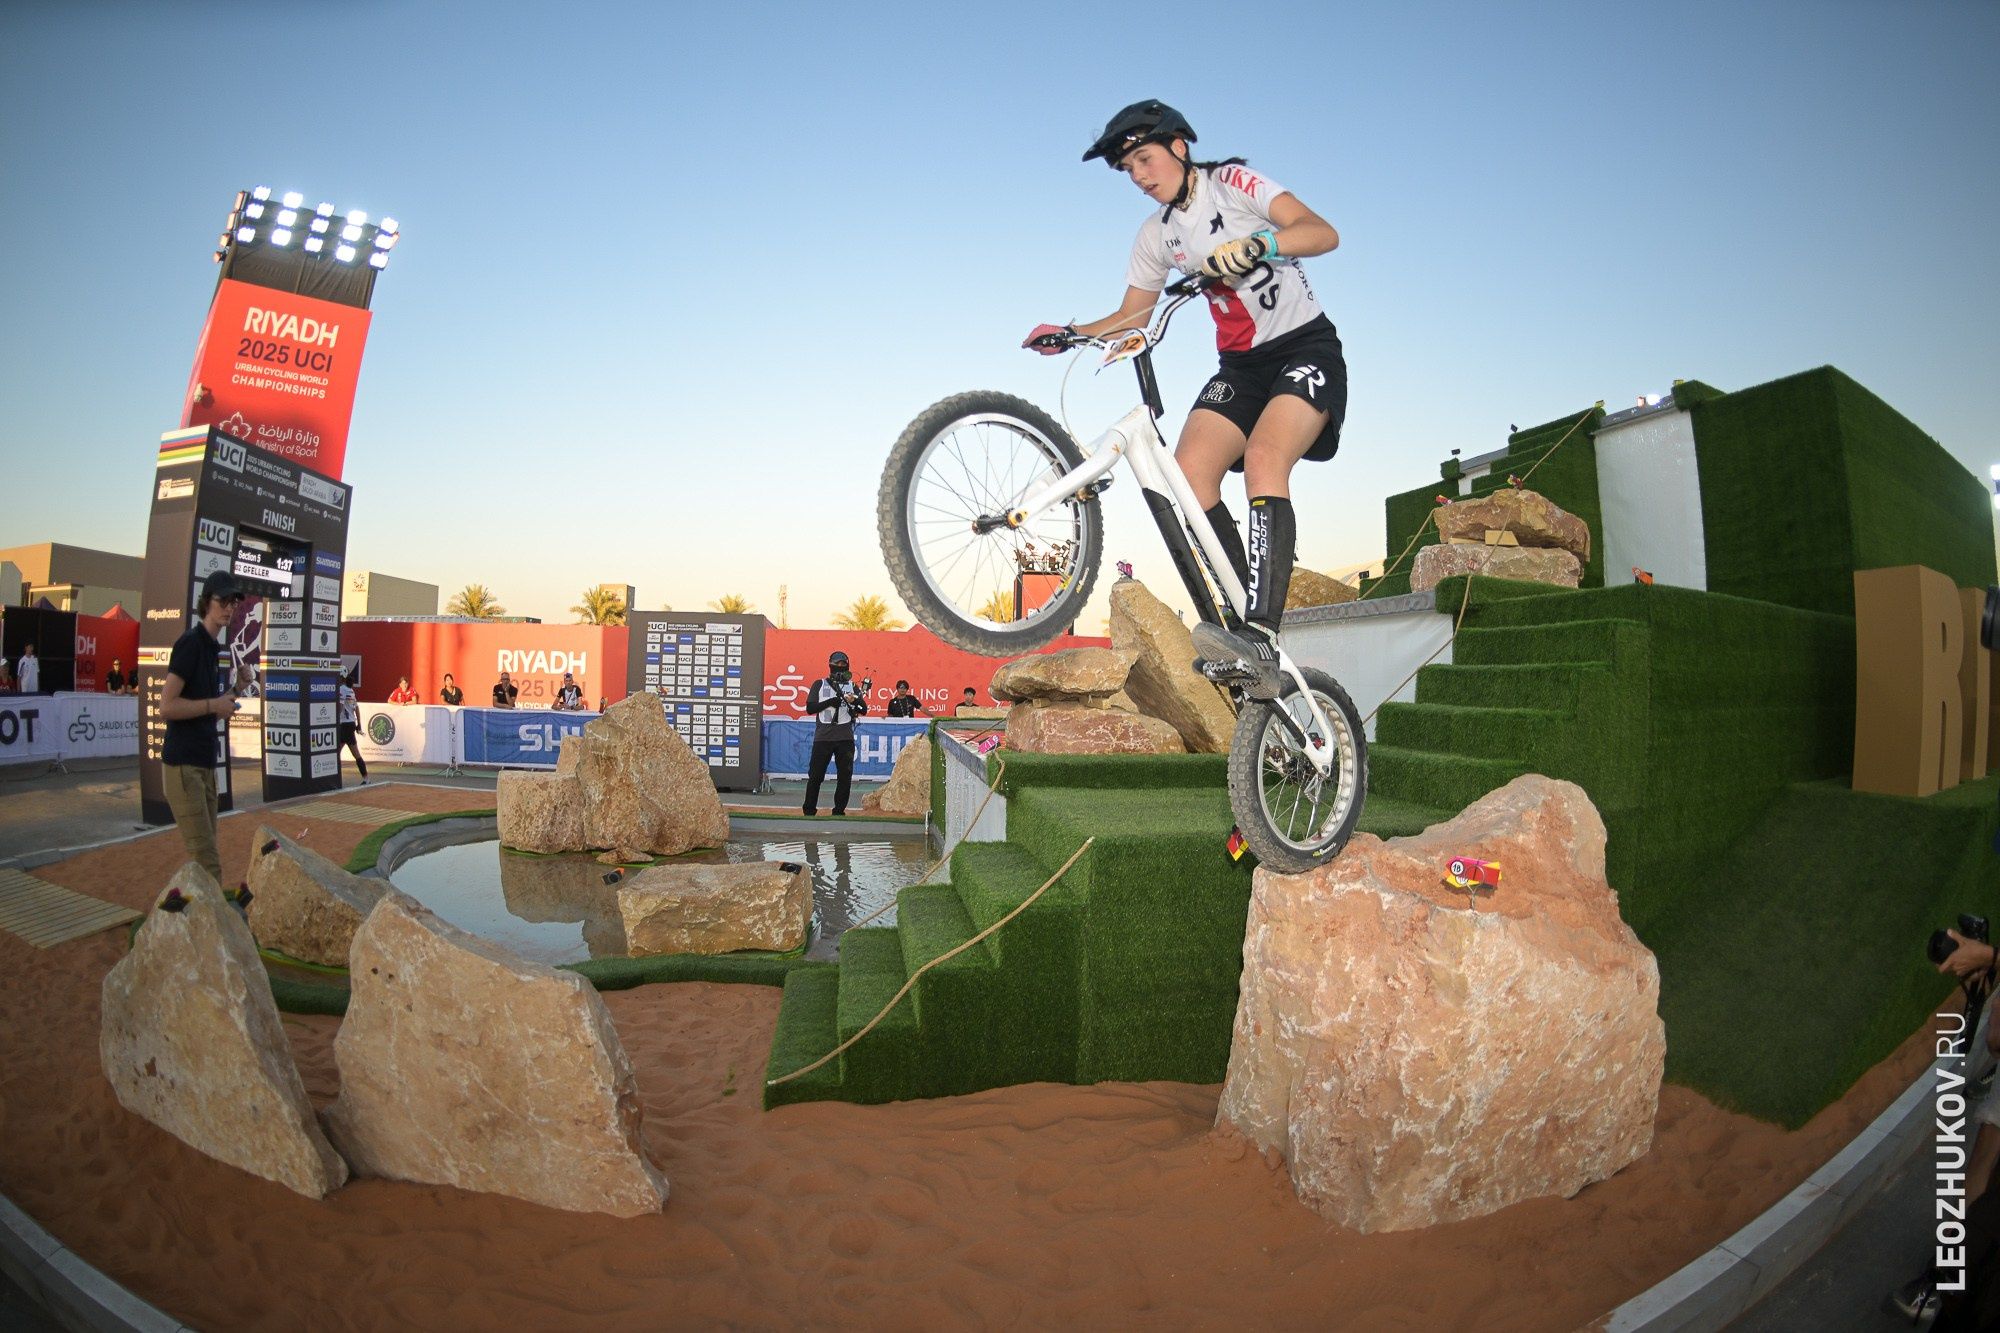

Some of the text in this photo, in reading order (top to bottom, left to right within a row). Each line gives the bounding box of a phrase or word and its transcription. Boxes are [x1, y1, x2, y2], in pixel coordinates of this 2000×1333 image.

[243, 307, 339, 348] RIYADH
[237, 338, 333, 372] 2025 UCI
[235, 362, 329, 386] URBAN CYCLING WORLD
[232, 374, 326, 399] CHAMPIONSHIPS
[1202, 393, 1223, 401] CYCLE
[258, 424, 320, 447] وزارة الرياضة
[256, 440, 317, 457] Ministry of Sport
[220, 444, 243, 467] UCI
[262, 508, 296, 532] FINISH
[207, 527, 230, 546] UCI
[238, 550, 261, 563] Section 5
[316, 557, 341, 569] SHIMANO
[243, 565, 269, 577] GFELLER
[277, 558, 293, 571] 1:37
[281, 586, 289, 598] 10
[316, 613, 335, 622] TISSOT
[154, 651, 169, 661] UCI
[498, 649, 586, 675] RIYADH
[275, 659, 290, 667] UCI
[318, 660, 329, 669] UCI
[265, 683, 299, 692] SHIMANO
[310, 684, 336, 692] SHIMANO
[878, 688, 949, 700] CYLING
[99, 721, 123, 730] SAUDI
[272, 732, 296, 747] UCI
[316, 732, 334, 747] UCI
